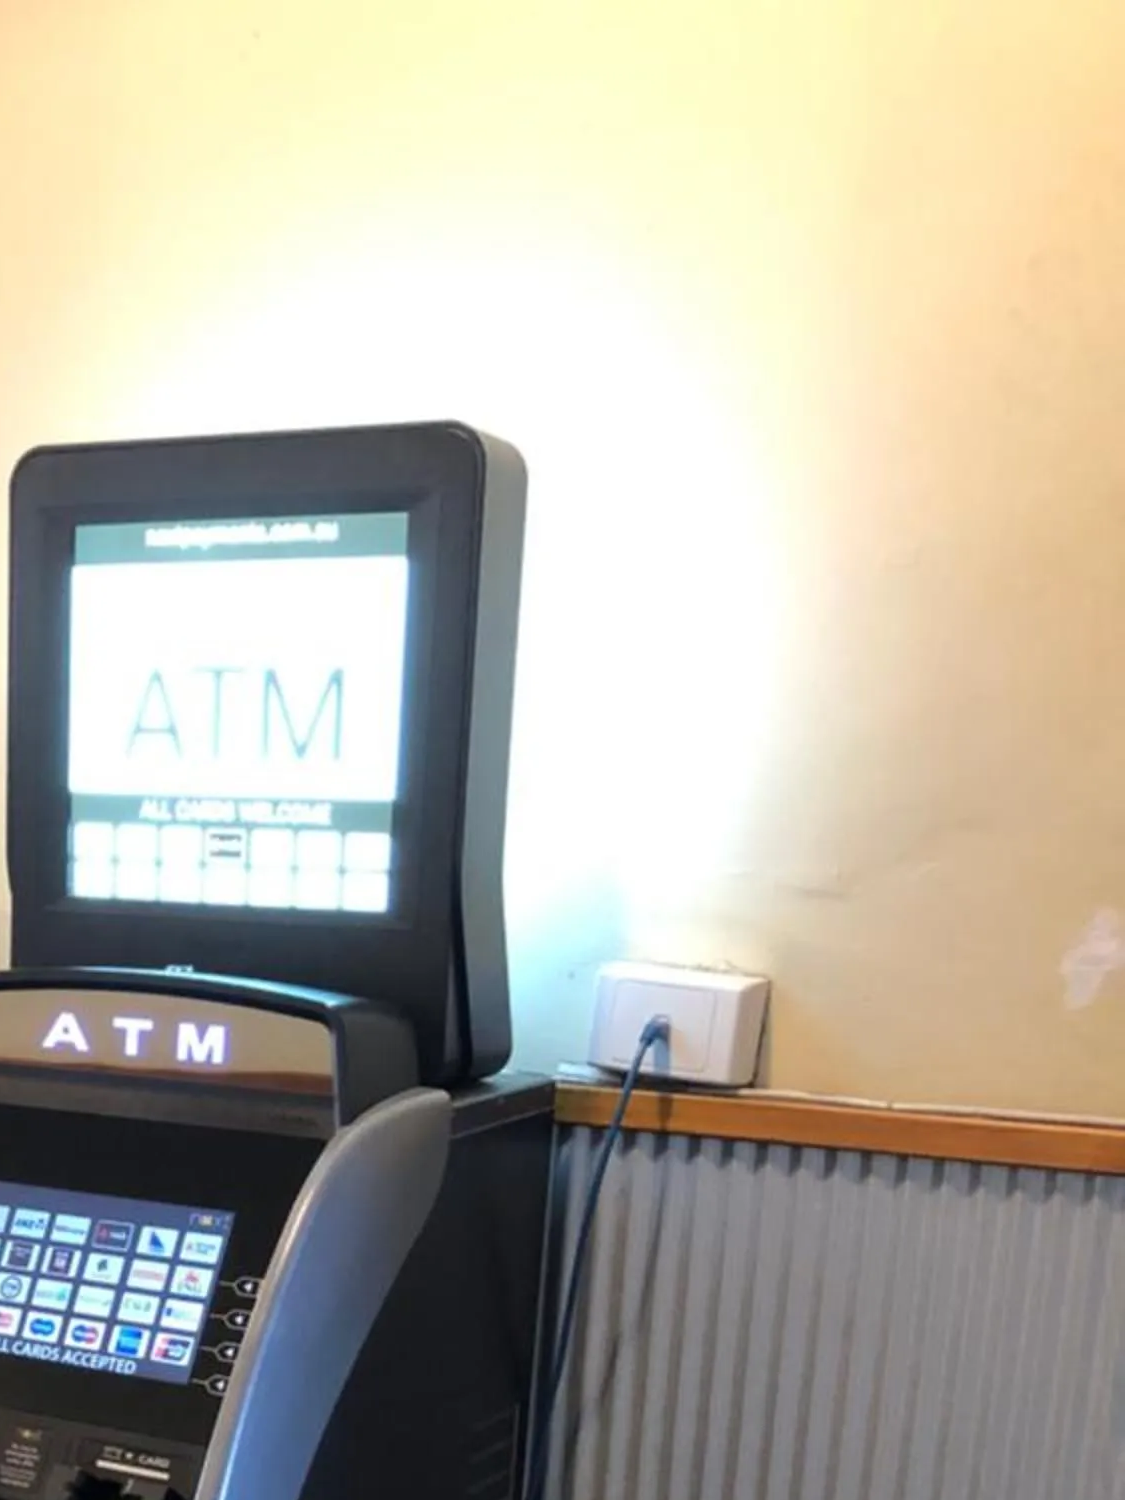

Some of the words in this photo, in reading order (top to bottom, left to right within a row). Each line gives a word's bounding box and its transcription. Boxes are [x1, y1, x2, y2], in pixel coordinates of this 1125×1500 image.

[126, 667, 345, 760] ATM
[42, 1012, 226, 1065] ATM
[11, 1341, 60, 1362] CARDS
[61, 1348, 137, 1375] ACCEPTED
